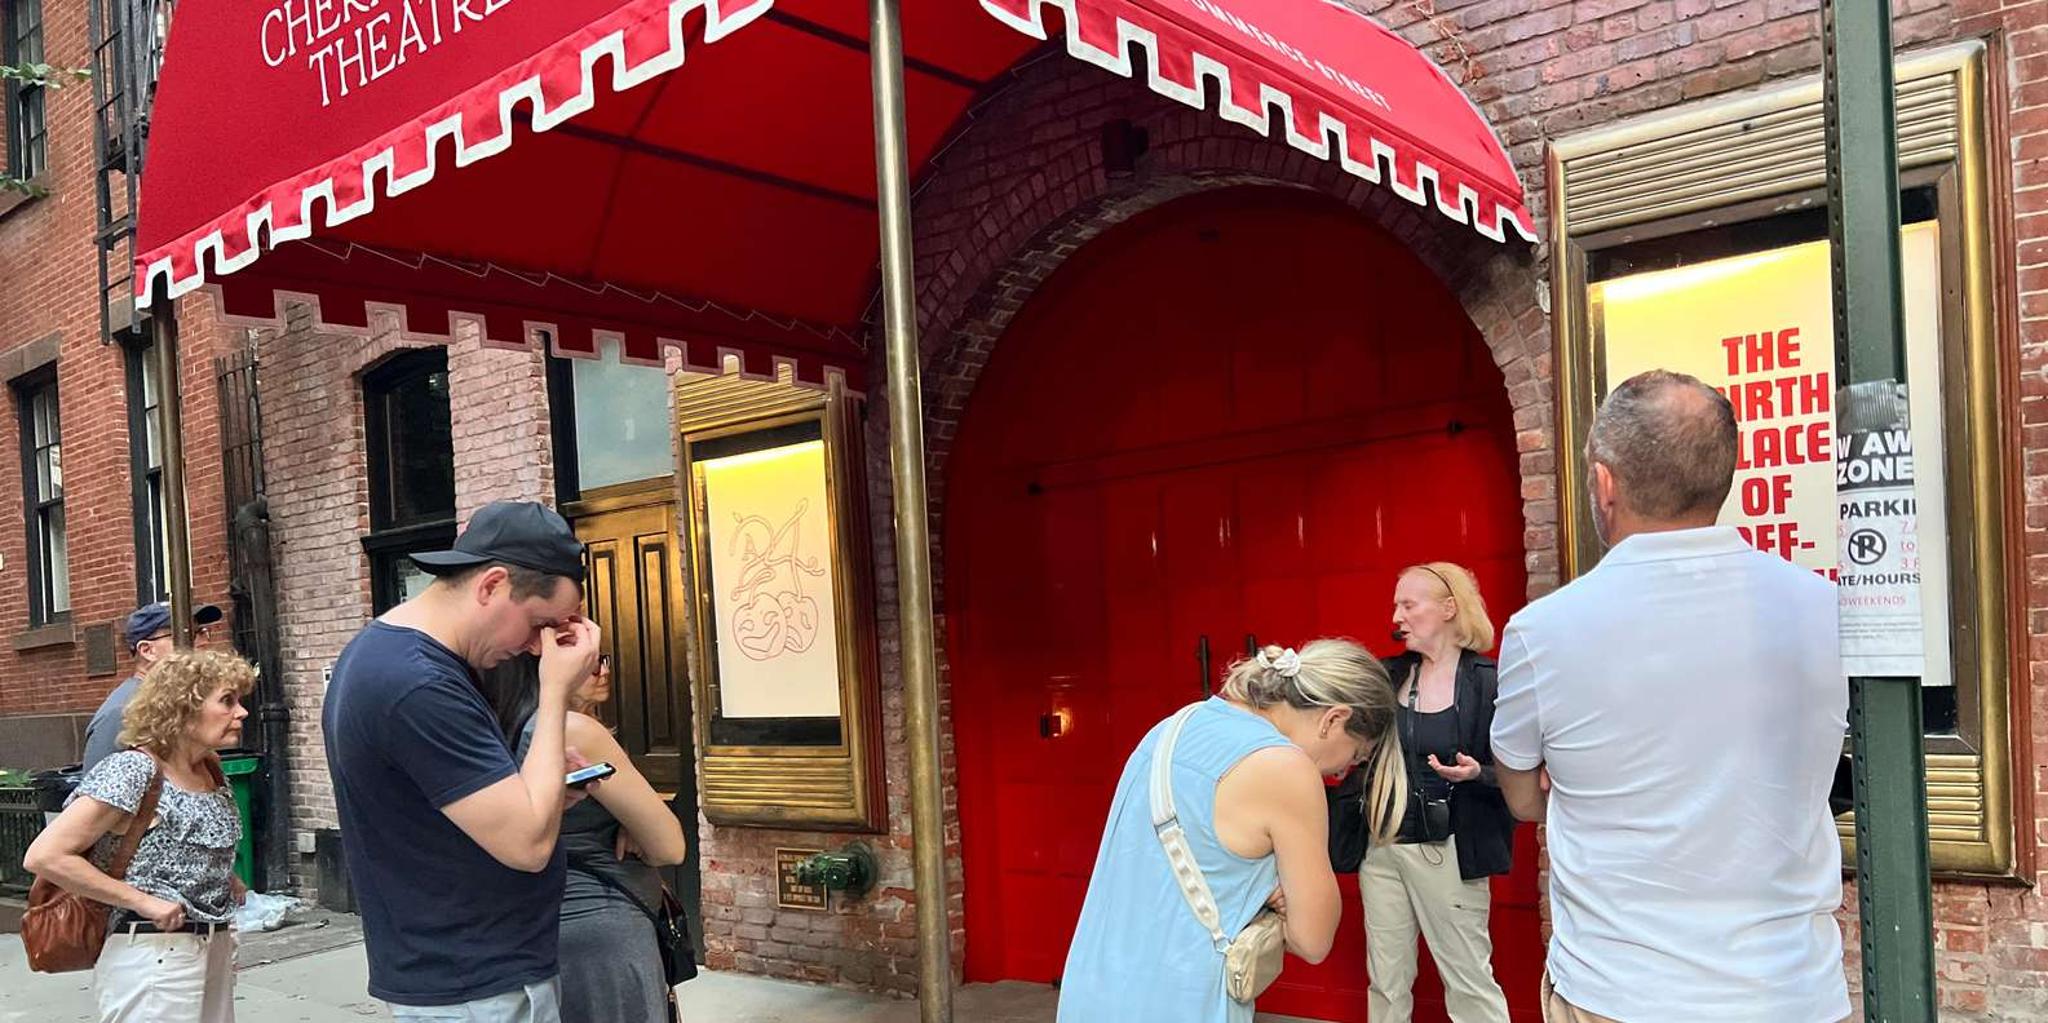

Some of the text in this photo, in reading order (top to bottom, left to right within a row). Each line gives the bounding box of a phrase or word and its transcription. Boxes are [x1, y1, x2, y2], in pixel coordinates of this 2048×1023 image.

[1190, 0, 1392, 112] OMMERCE STREET
[1722, 327, 1801, 376] THE
[1715, 372, 1830, 422] IRTH
[1736, 421, 1831, 470] LACE
[1837, 455, 1913, 485] ZONE
[1742, 474, 1793, 517] OF
